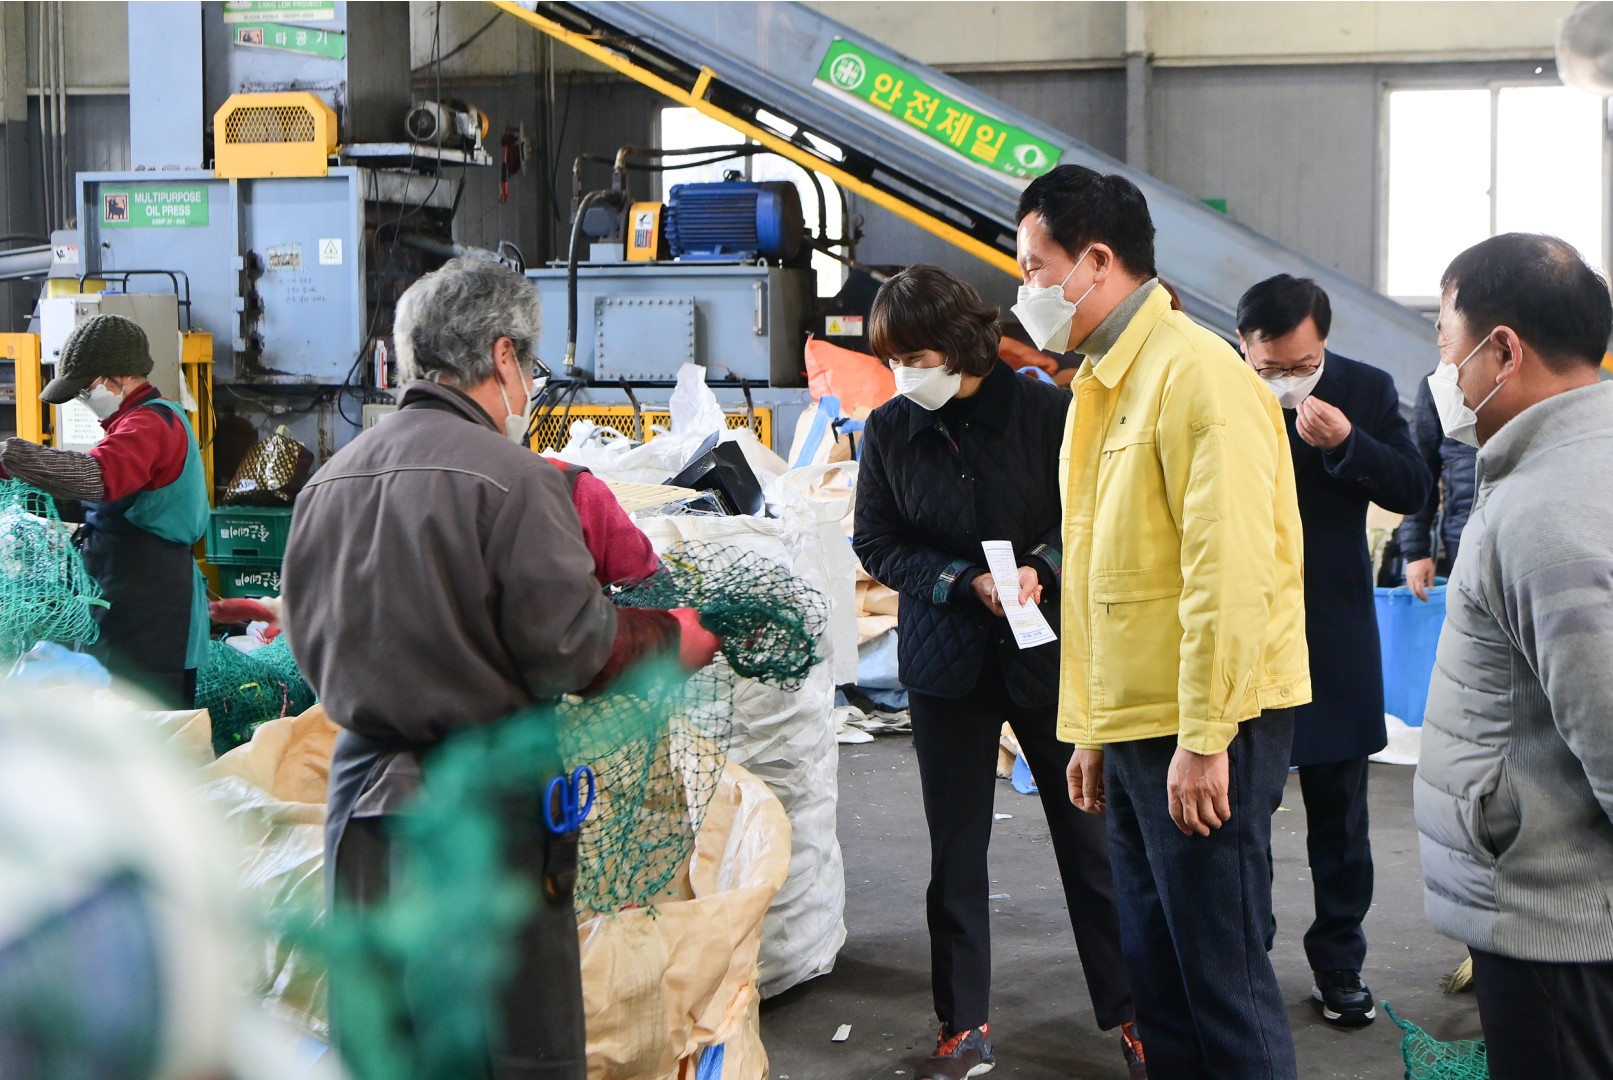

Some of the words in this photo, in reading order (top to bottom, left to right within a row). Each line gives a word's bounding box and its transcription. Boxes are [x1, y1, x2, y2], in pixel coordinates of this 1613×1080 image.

[869, 73, 1008, 163] 안전제일
[134, 191, 201, 203] MULTIPURPOSE
[145, 205, 160, 217] OIL
[162, 204, 191, 217] PRESS
[230, 525, 269, 542] 좋은데이
